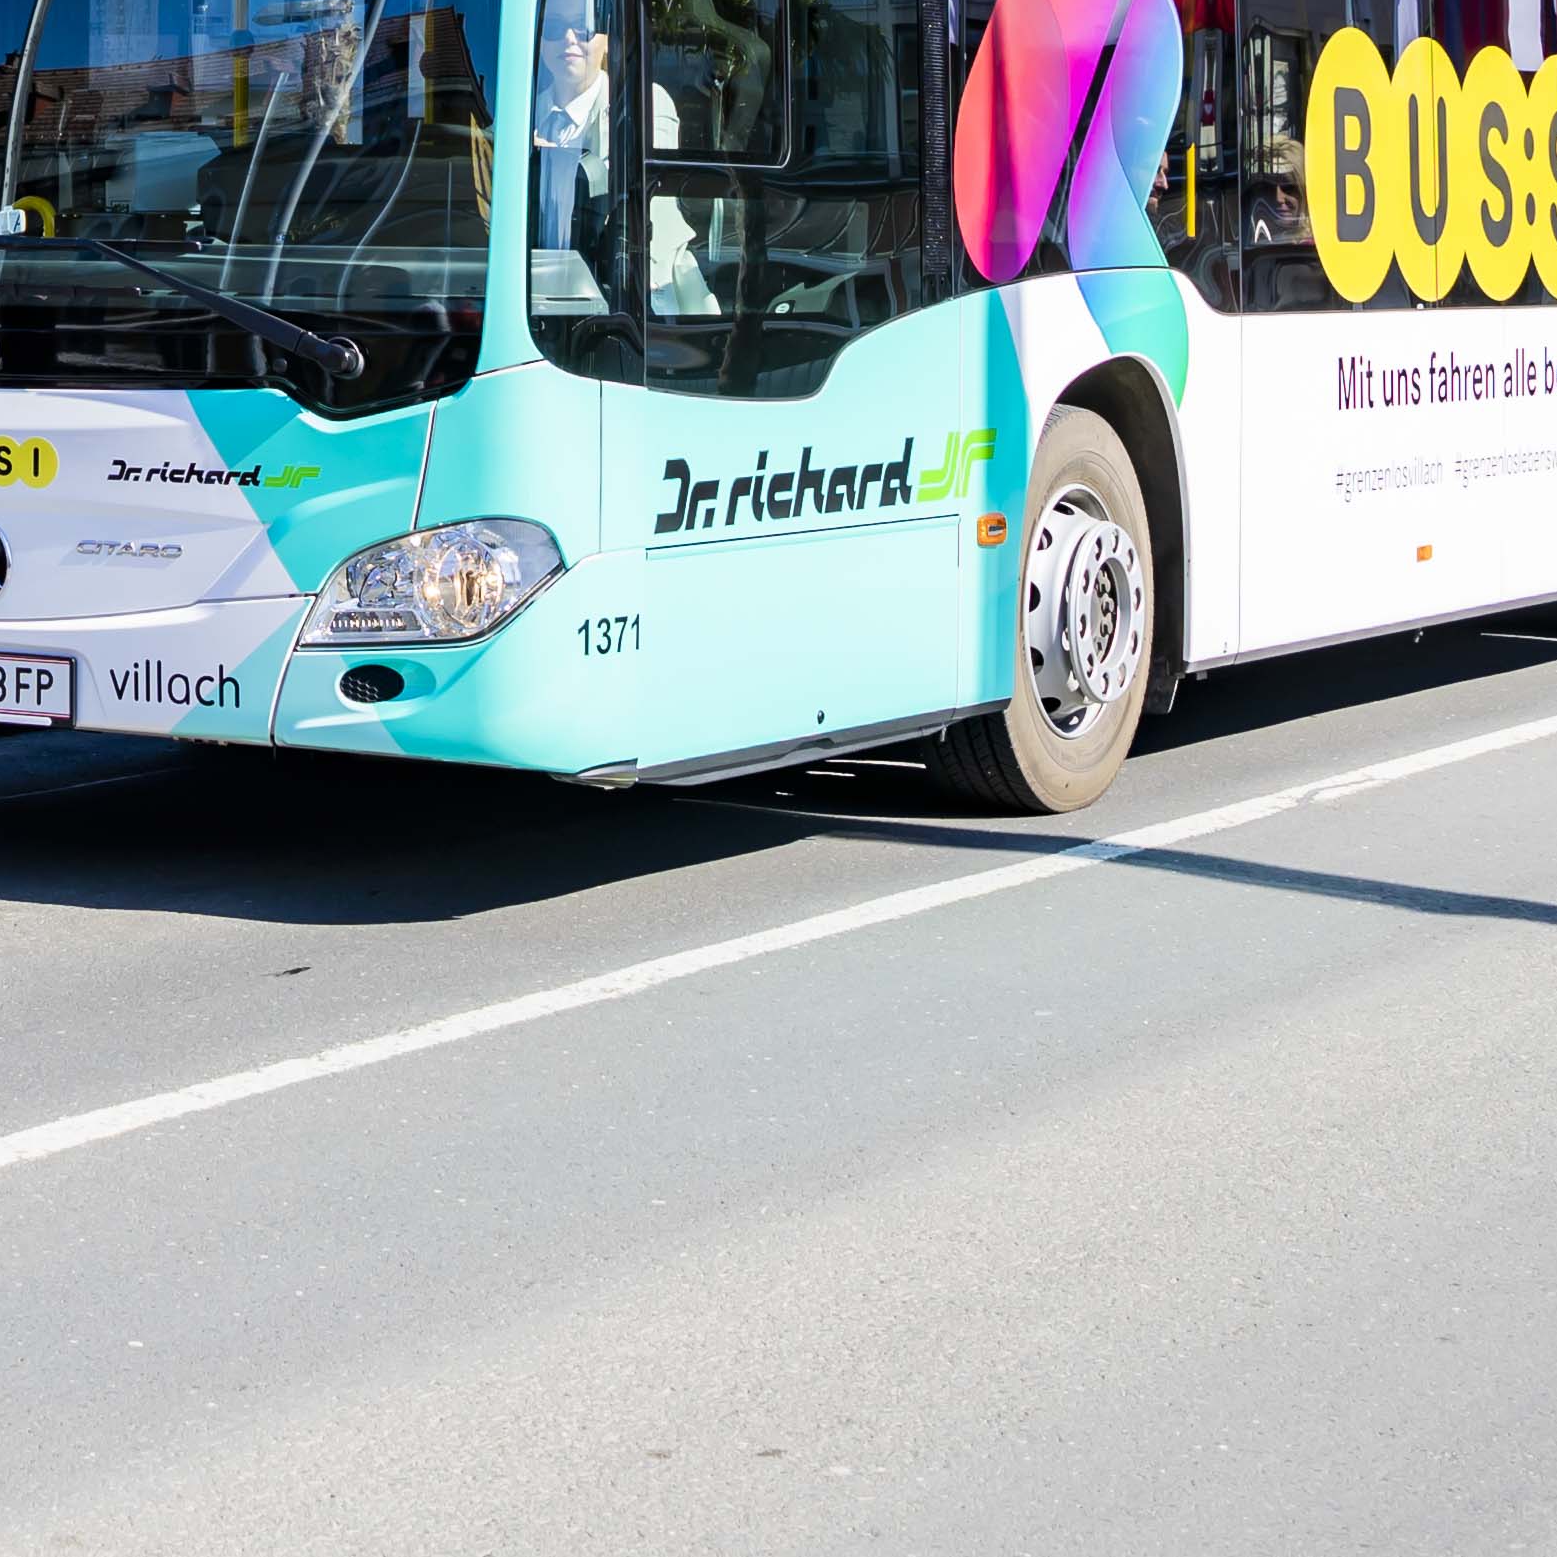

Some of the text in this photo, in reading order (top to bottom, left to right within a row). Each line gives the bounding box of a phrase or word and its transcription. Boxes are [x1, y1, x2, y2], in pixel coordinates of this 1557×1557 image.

[1338, 355, 1374, 411] Mit
[1382, 367, 1421, 407] uns
[1428, 350, 1495, 404] fahren
[1503, 347, 1537, 398] alle
[75, 539, 185, 560] CITARO
[576, 612, 641, 657] 1371
[109, 659, 241, 708] villach
